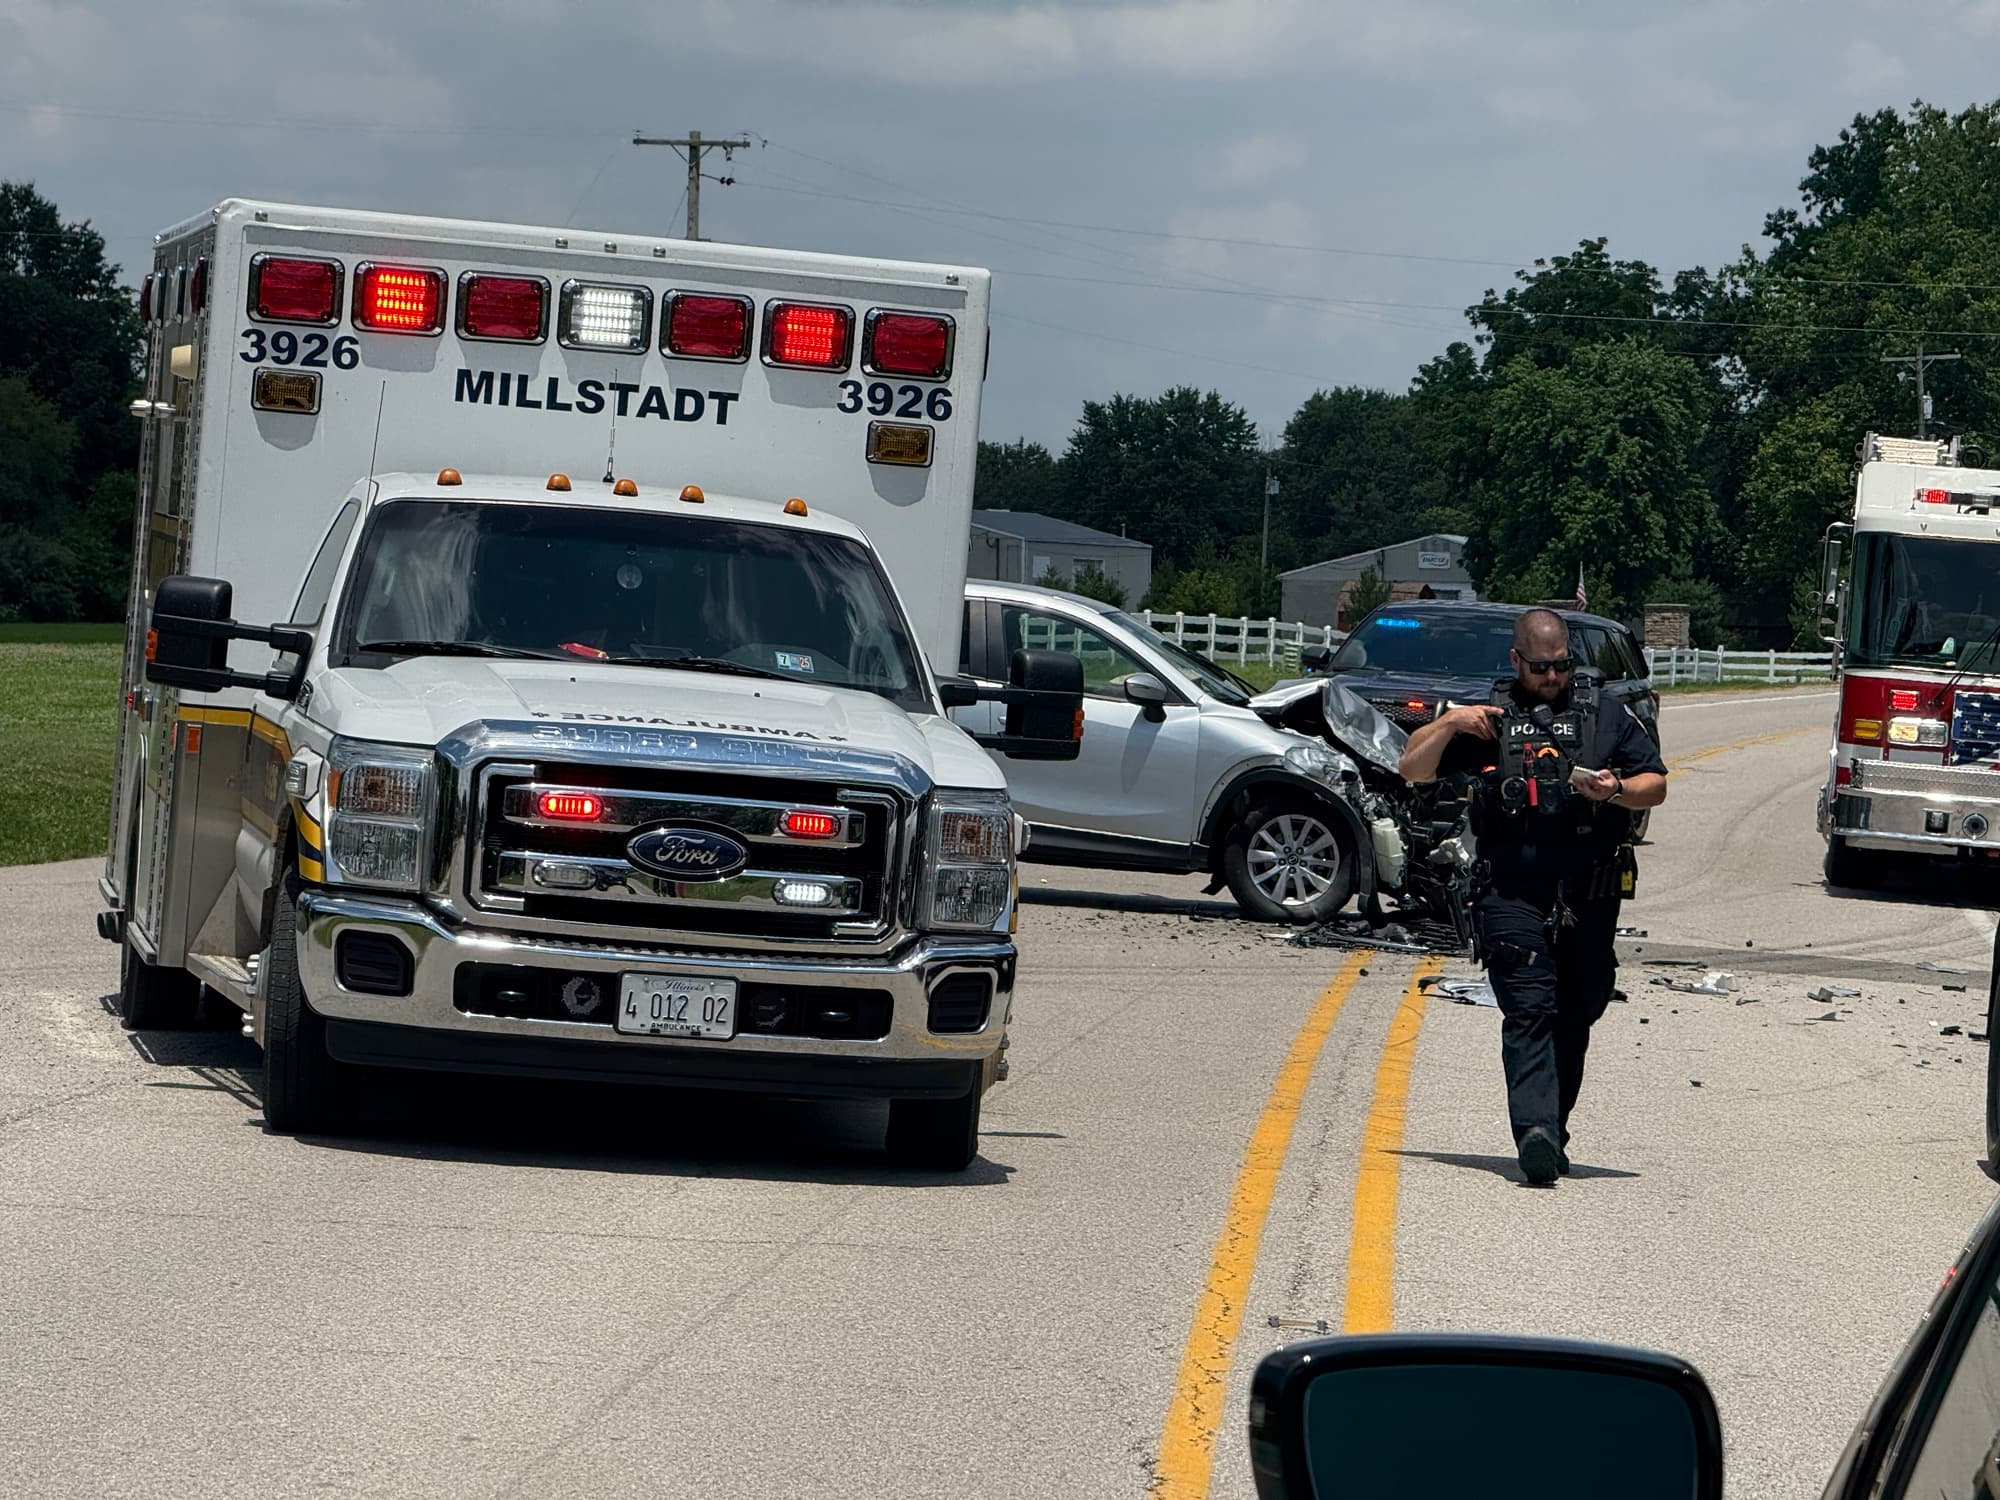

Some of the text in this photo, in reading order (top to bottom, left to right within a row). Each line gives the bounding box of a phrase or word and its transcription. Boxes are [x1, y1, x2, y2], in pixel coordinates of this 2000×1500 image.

[239, 328, 360, 370] 3926
[454, 368, 740, 426] MILLSTADT
[836, 379, 953, 422] 3926
[531, 725, 698, 753] SUPER
[1511, 723, 1574, 736] POLCE
[655, 835, 721, 865] Ford
[664, 979, 706, 992] Illinois
[625, 991, 729, 1024] 4 012 02
[651, 1022, 702, 1032] AMBULANCE
